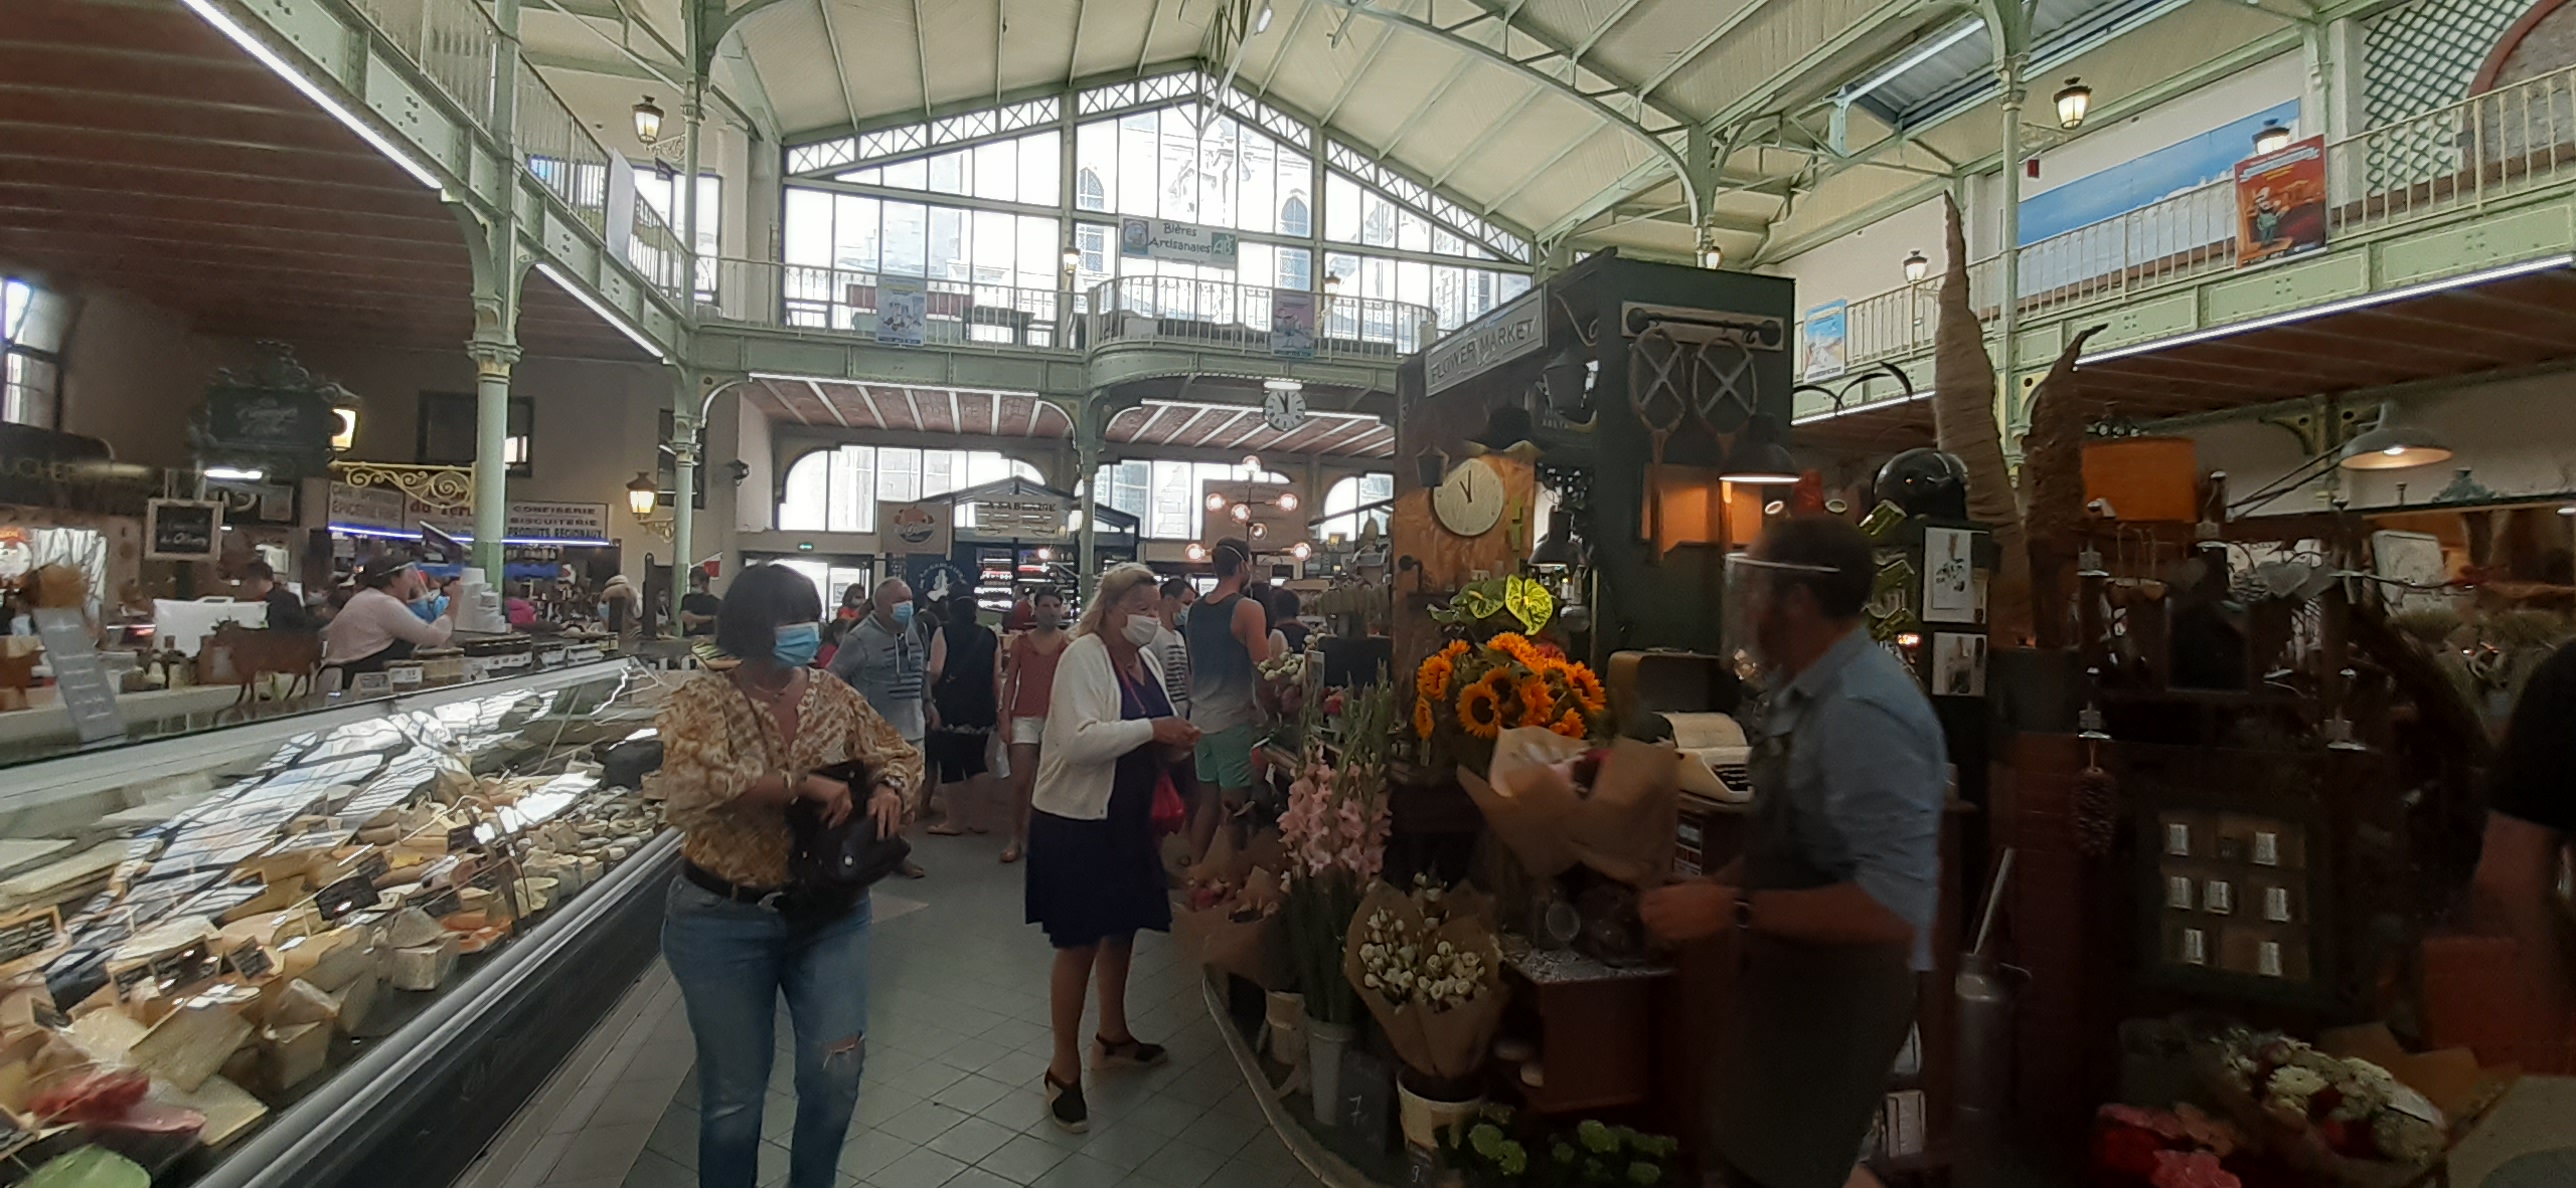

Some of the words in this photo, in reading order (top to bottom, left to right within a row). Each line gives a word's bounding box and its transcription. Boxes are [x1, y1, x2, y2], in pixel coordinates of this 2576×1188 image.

[1147, 236, 1211, 254] Artisanales
[1430, 340, 1477, 383] FLOWER
[1480, 318, 1538, 352] MARKET
[513, 505, 597, 515] CONFISERIE
[510, 517, 598, 526] BISCUITERIE
